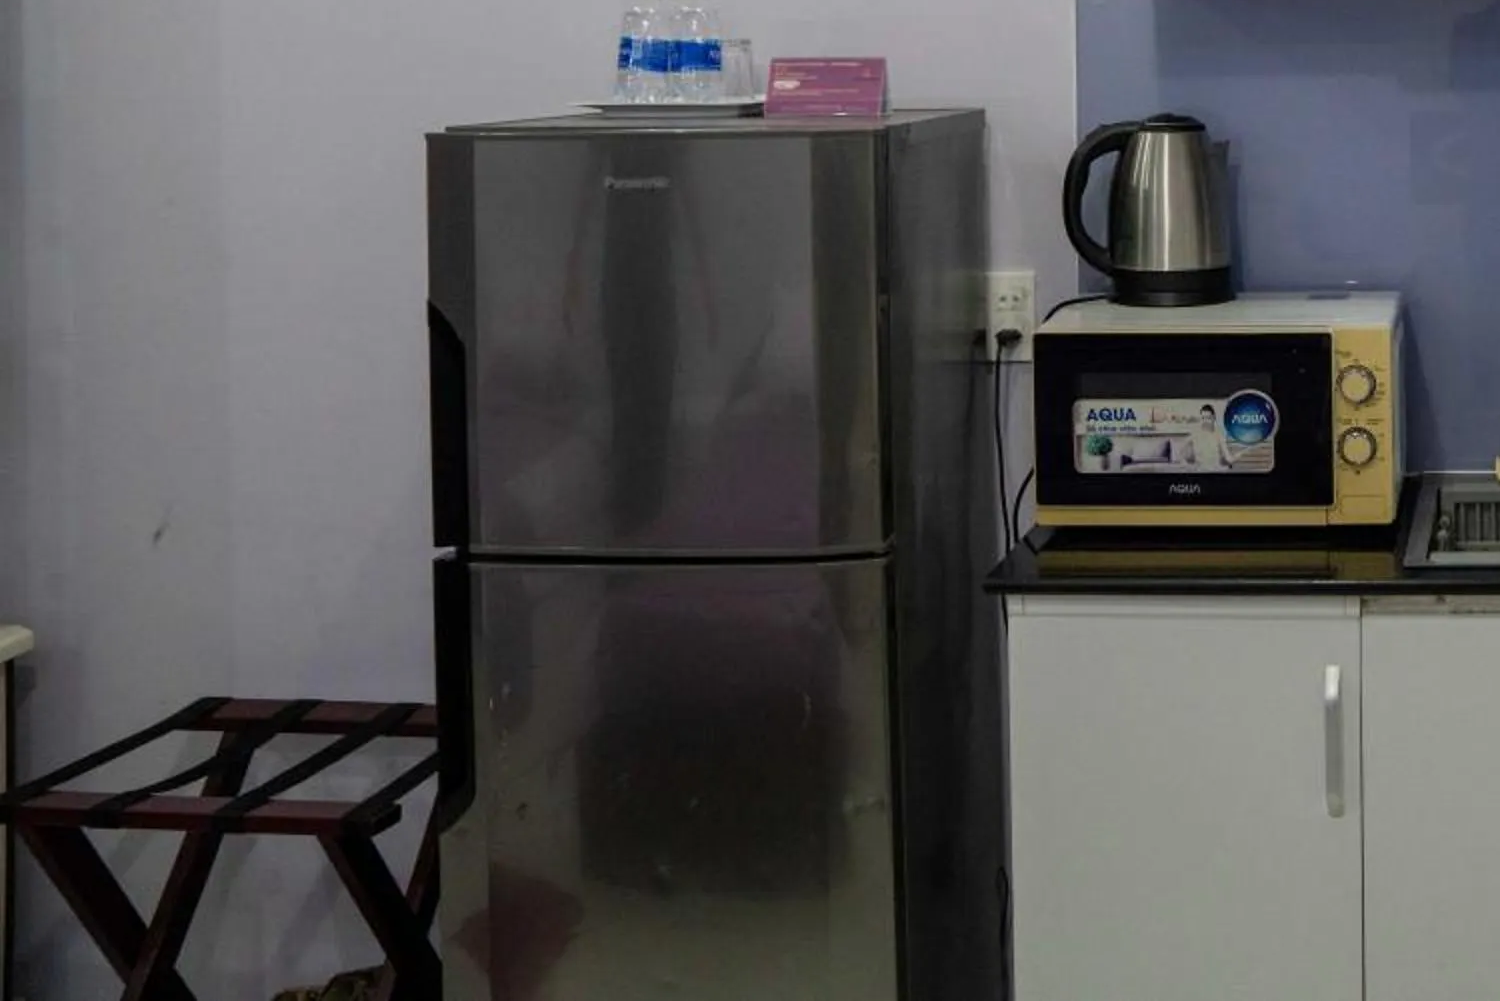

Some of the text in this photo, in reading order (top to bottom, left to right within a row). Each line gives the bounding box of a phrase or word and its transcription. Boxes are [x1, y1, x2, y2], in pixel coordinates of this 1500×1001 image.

[1087, 407, 1137, 423] AQUA
[1231, 413, 1269, 425] AQUA
[1168, 482, 1201, 495] AQUA
